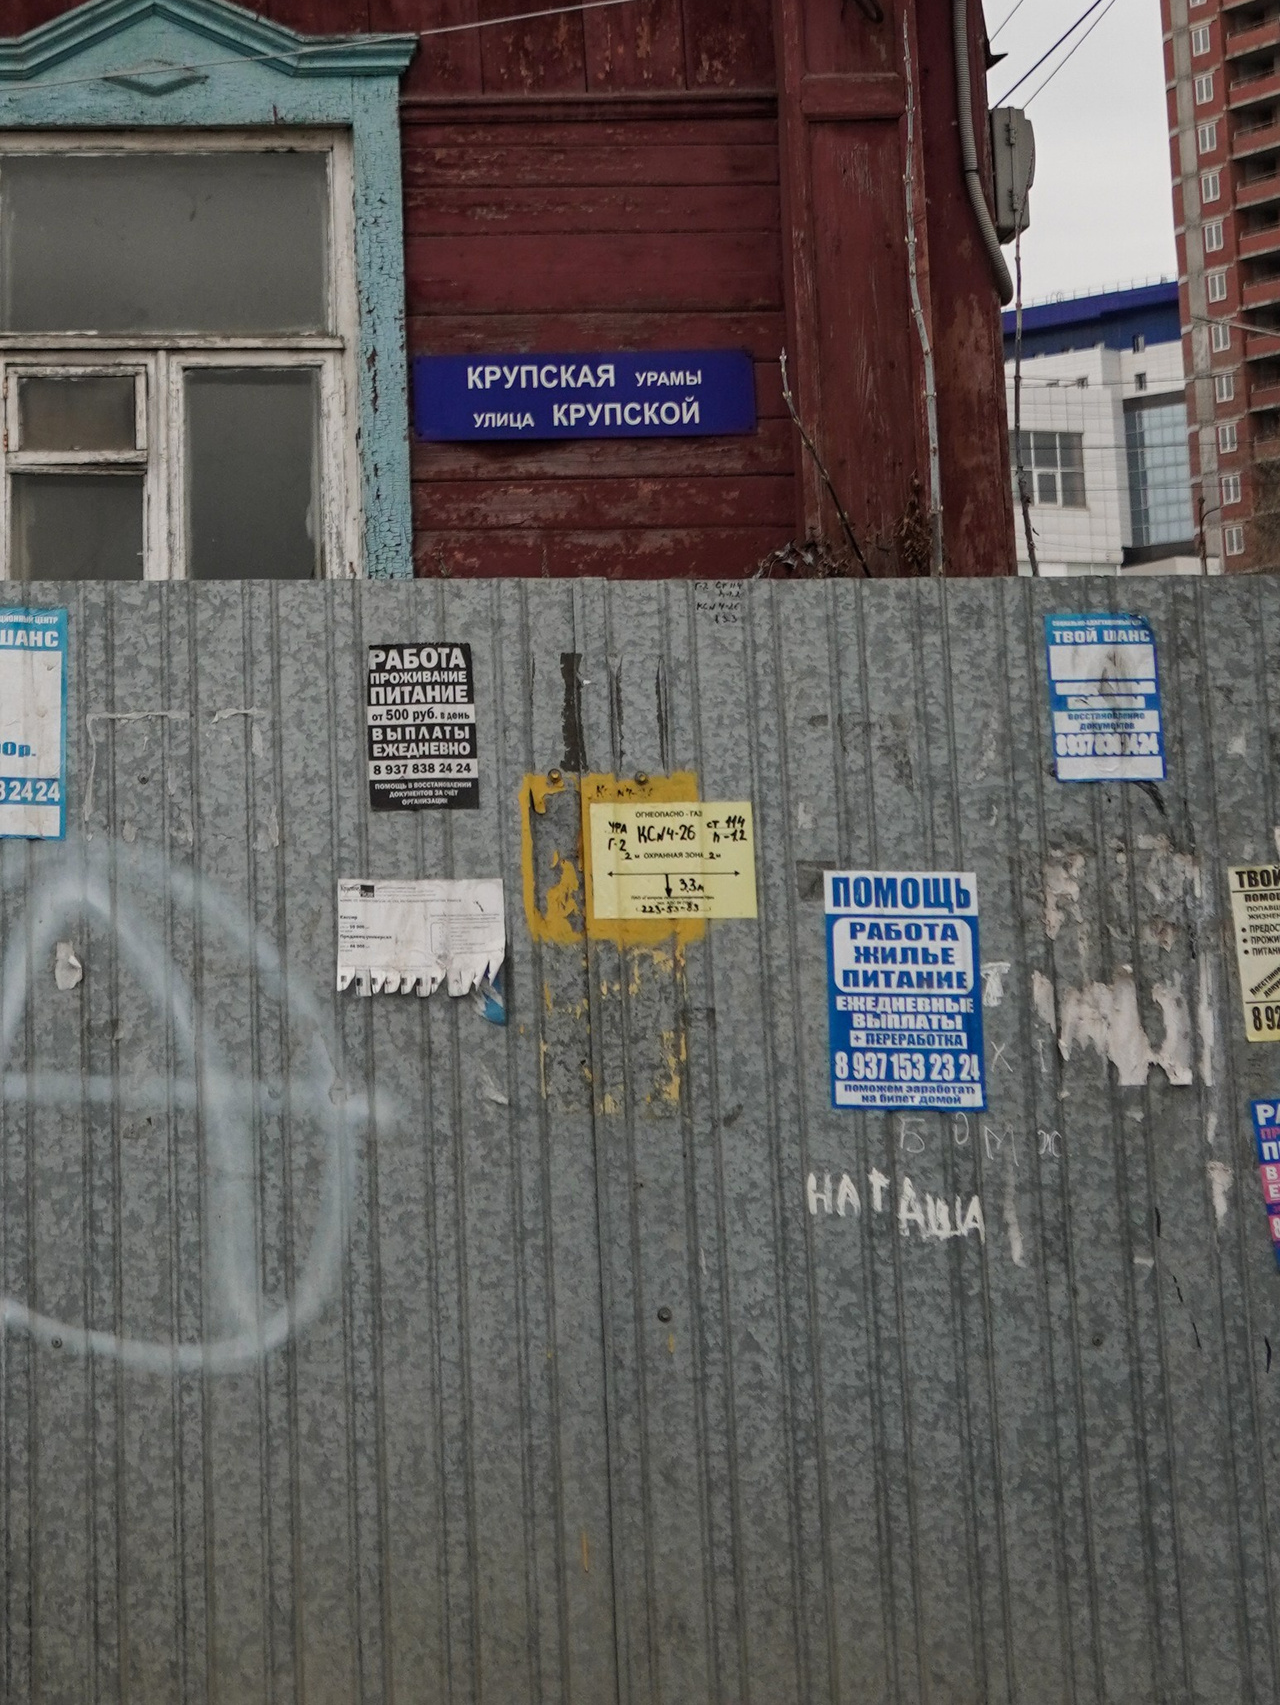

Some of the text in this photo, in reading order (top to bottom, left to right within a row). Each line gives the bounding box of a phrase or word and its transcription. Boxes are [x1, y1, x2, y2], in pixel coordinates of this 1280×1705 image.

[467, 364, 702, 390] КРУПСКАЯ УРАМЫ
[473, 396, 700, 430] УЛИЦА КРУПСКОЙ
[35, 616, 58, 624] ЦЕНТР
[1053, 627, 1150, 644] ТВОЙ ШАНС
[368, 647, 467, 670] РАБОТА
[370, 671, 467, 684] ПРОЖИВАНИЕ
[370, 685, 468, 704] ПИТАНИЕ
[386, 709, 409, 720] 500
[413, 707, 438, 722] руб.
[372, 726, 470, 741] ВЫПЛАТЫ
[373, 742, 471, 758] ЕЖЕДНЕВНО
[373, 763, 471, 775] 8 937 838 24 24
[8, 781, 33, 801] 24
[35, 782, 60, 802] 24
[389, 790, 433, 798] ДОКУМЕНТОВ
[725, 815, 745, 828] 114
[832, 877, 971, 914] ПОМОЩЬ
[849, 922, 959, 941] РАБОТА
[854, 946, 955, 965] ЖИЛЬЕ
[842, 970, 968, 989] ПИТАНИЕ
[836, 996, 974, 1013] ЕЖЕДНЕВНЫЕ
[852, 1013, 963, 1030] ВЫПЛАТЫ
[1252, 1006, 1262, 1031] 8
[865, 1032, 963, 1046] ПЕРЕРАБОТКА
[835, 1051, 980, 1081] 8 937 153 23 24
[844, 1084, 903, 1093] поможем
[919, 1094, 962, 1104] домой
[807, 1168, 986, 1244] НАТАША
